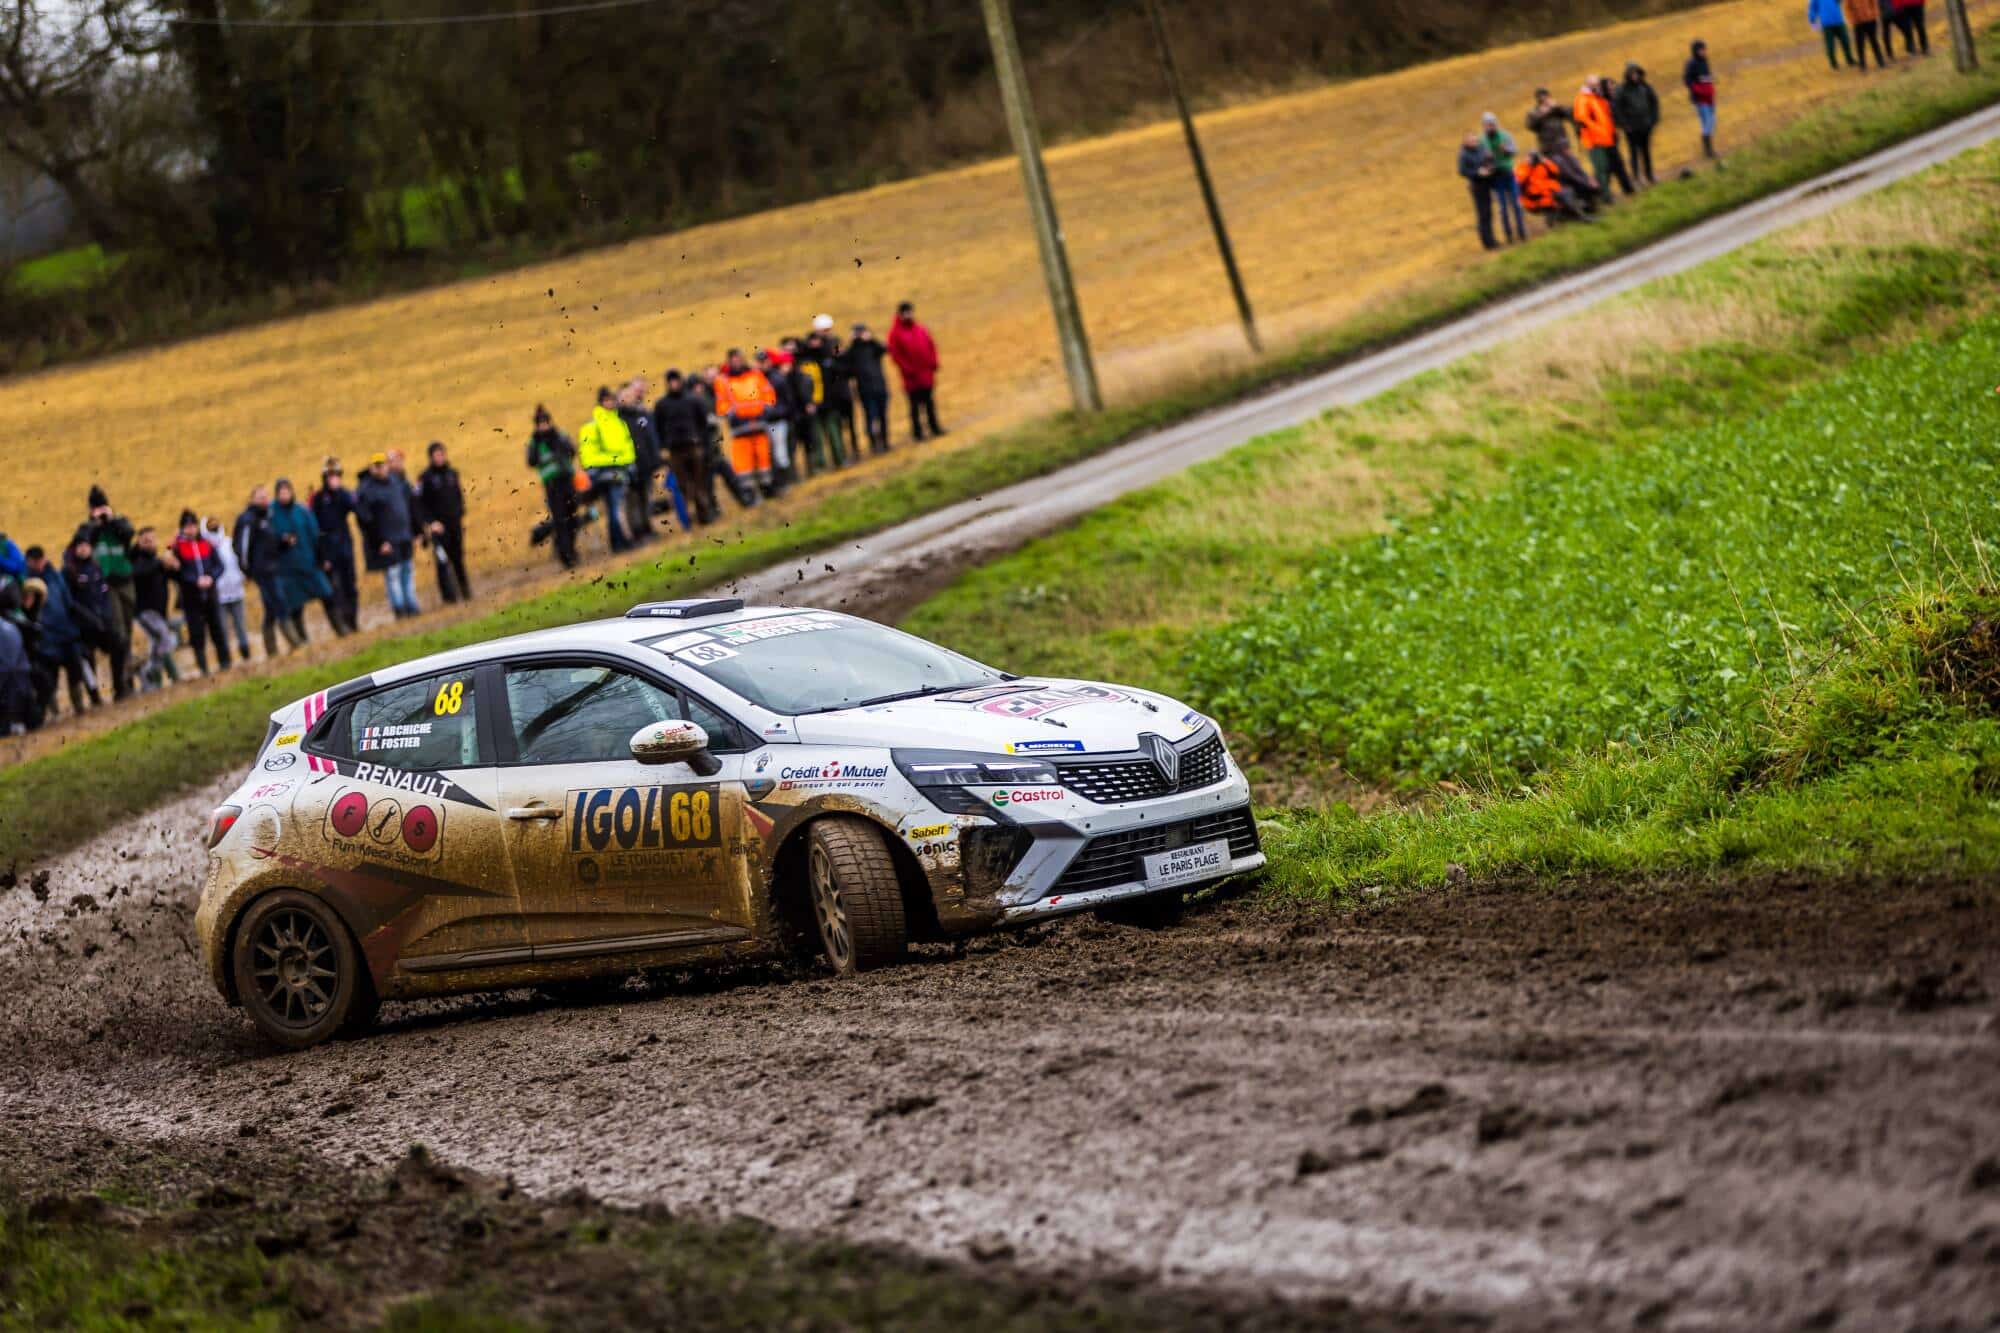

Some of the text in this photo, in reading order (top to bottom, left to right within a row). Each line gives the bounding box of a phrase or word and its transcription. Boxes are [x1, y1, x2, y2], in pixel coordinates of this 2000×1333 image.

[688, 646, 727, 660] 68
[434, 681, 463, 715] 68
[371, 737, 420, 750] R. FOSTIER
[781, 766, 888, 779] Crédit Mutuel
[354, 762, 453, 798] RENAULT
[793, 782, 824, 790] banque
[1011, 789, 1064, 803] Castrol
[344, 806, 425, 836] F S
[572, 787, 664, 851] IGOL
[670, 790, 712, 841] 68
[912, 826, 946, 839] Sabelt
[1171, 846, 1205, 860] RESTAURANT
[1160, 864, 1169, 876] LE
[1171, 858, 1193, 874] PARIS
[1194, 852, 1220, 868] PLAGE
